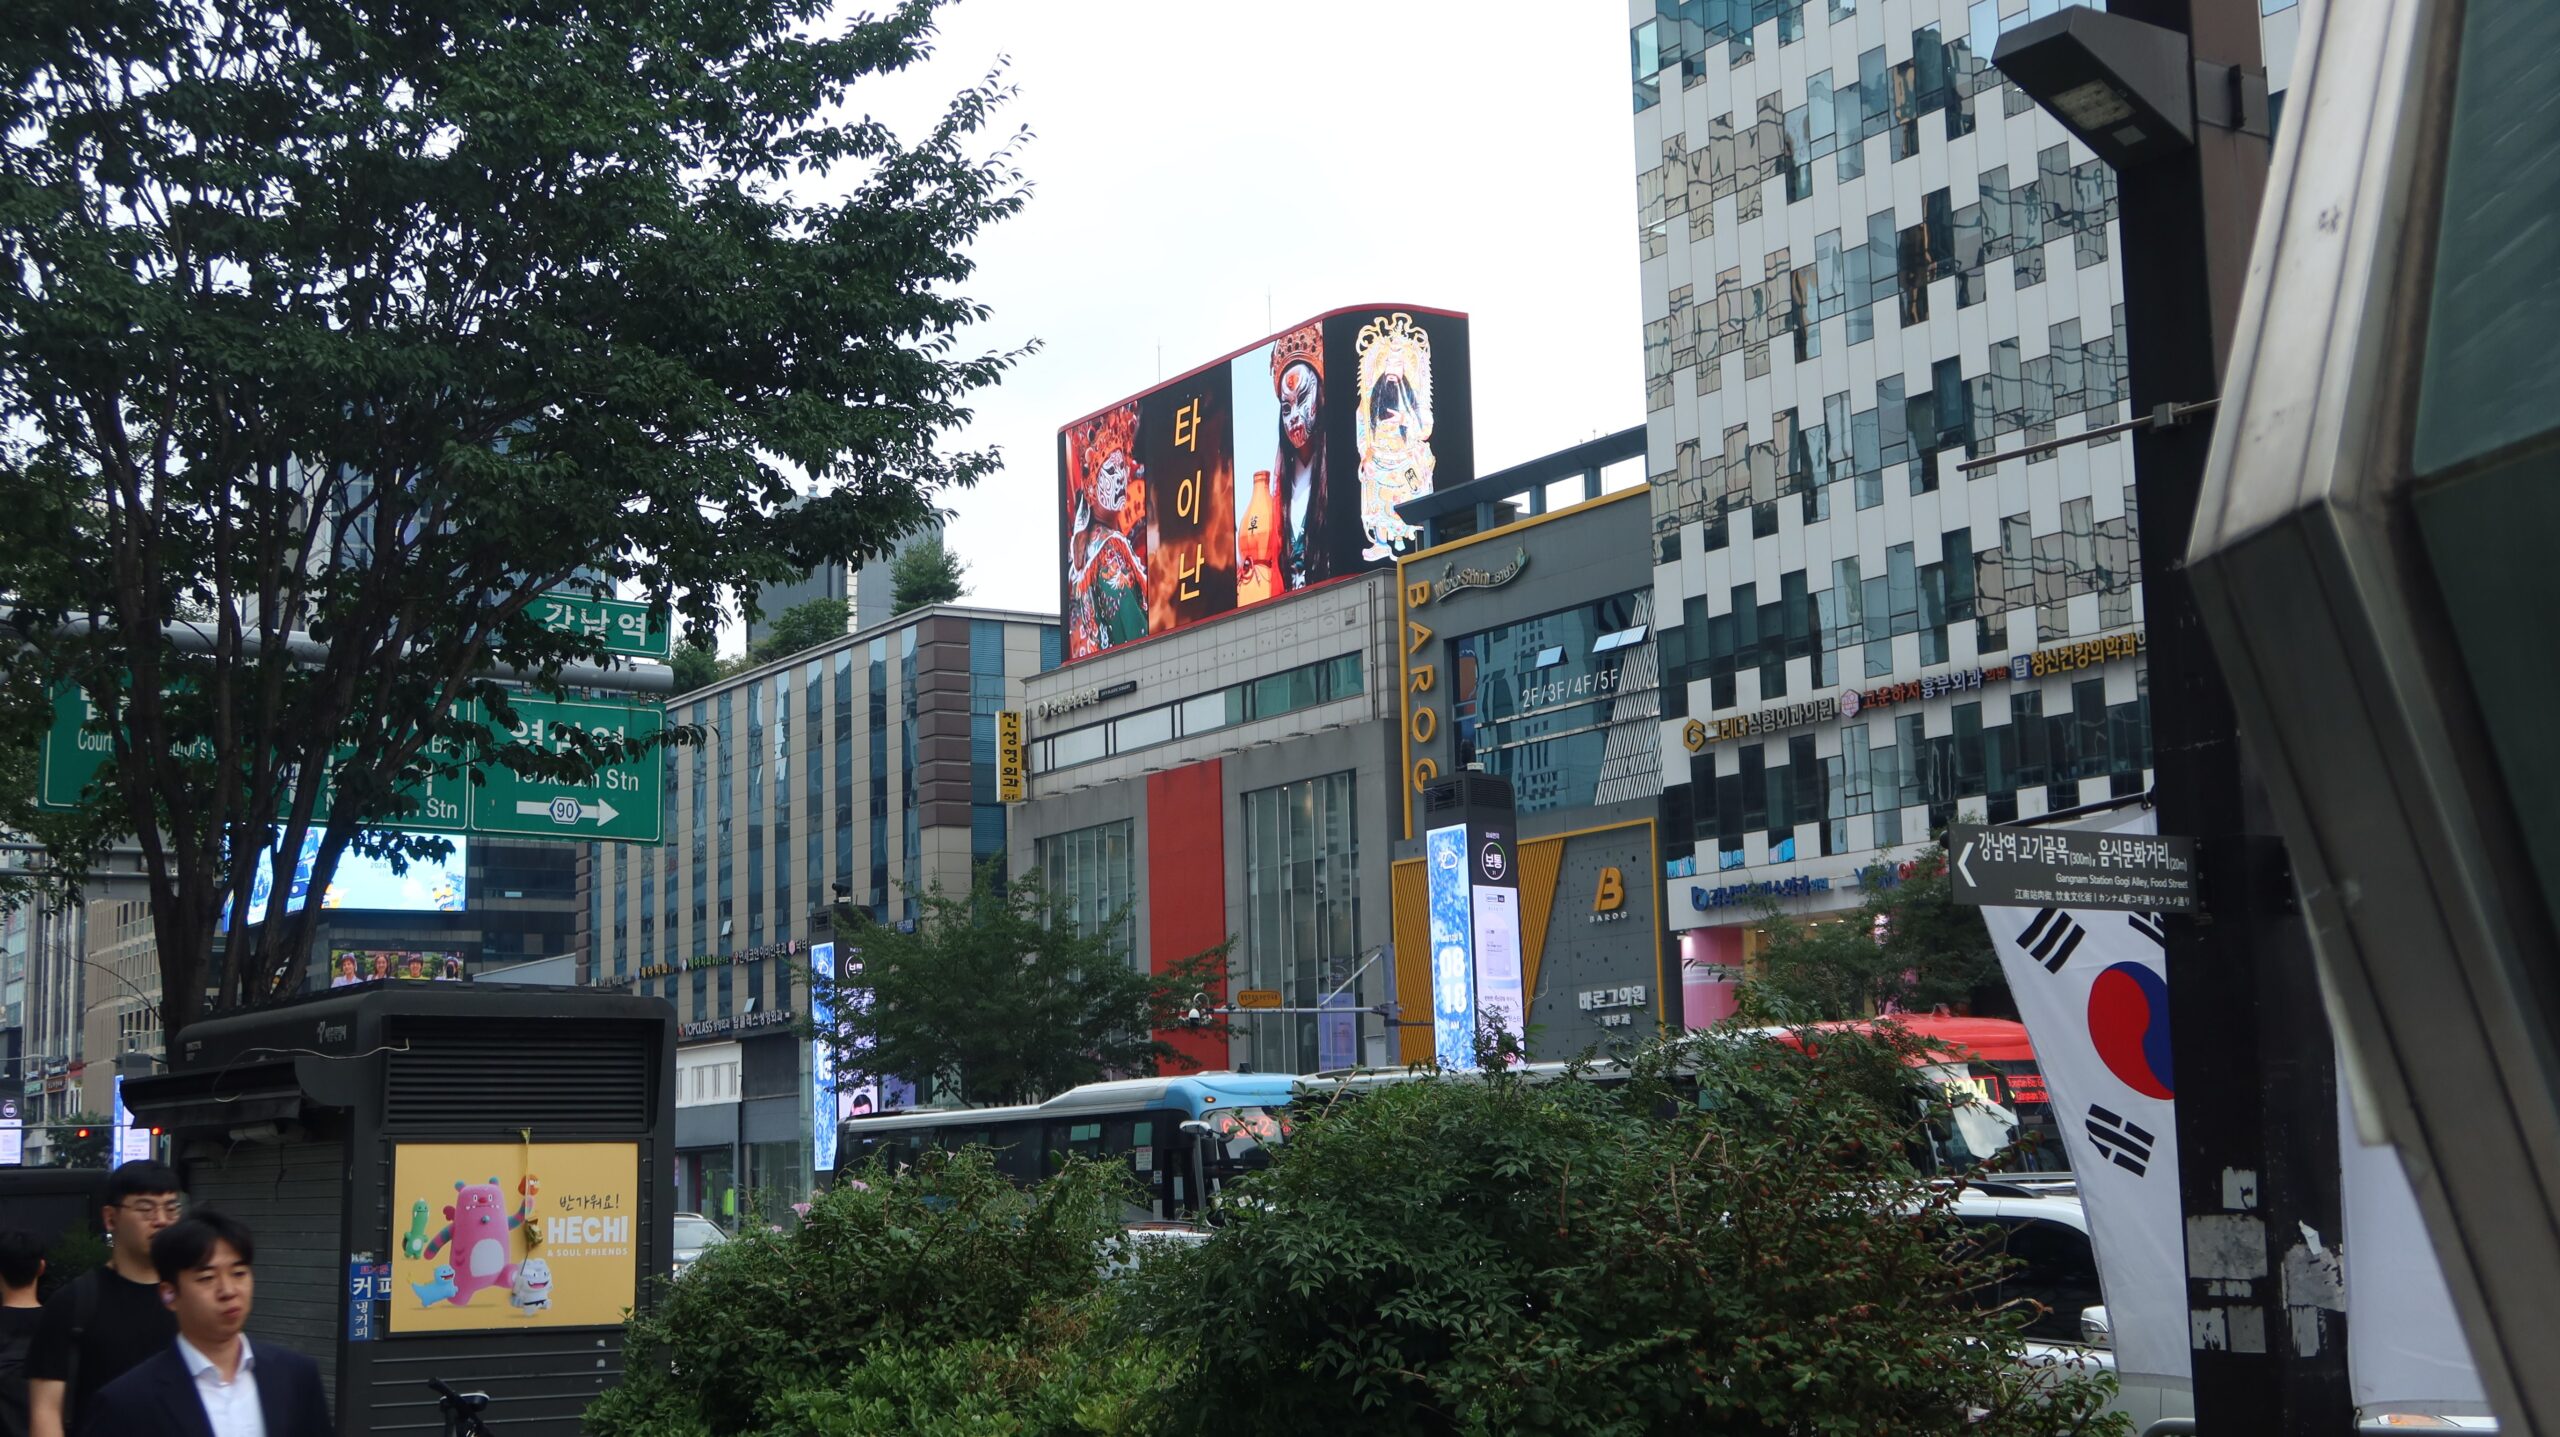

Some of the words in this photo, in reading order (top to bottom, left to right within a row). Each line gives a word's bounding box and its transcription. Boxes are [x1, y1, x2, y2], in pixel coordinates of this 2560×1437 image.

[1174, 398, 1204, 602] 타이난
[1522, 668, 1619, 708] 2F/3F/4F/5F
[78, 728, 113, 752] Court
[606, 768, 639, 791] Stn
[426, 798, 458, 819] Stn
[556, 802, 574, 818] 90
[1978, 831, 2017, 863] 강남역
[1485, 853, 1503, 869] 보통
[2089, 874, 2113, 885] Station
[2150, 878, 2168, 888] Food
[1579, 985, 1647, 1011] 바로그의원
[559, 1193, 620, 1211] 반가워요!
[547, 1215, 629, 1244] HECHI
[556, 1248, 581, 1257] SOUL
[584, 1247, 629, 1257] FRIENDS
